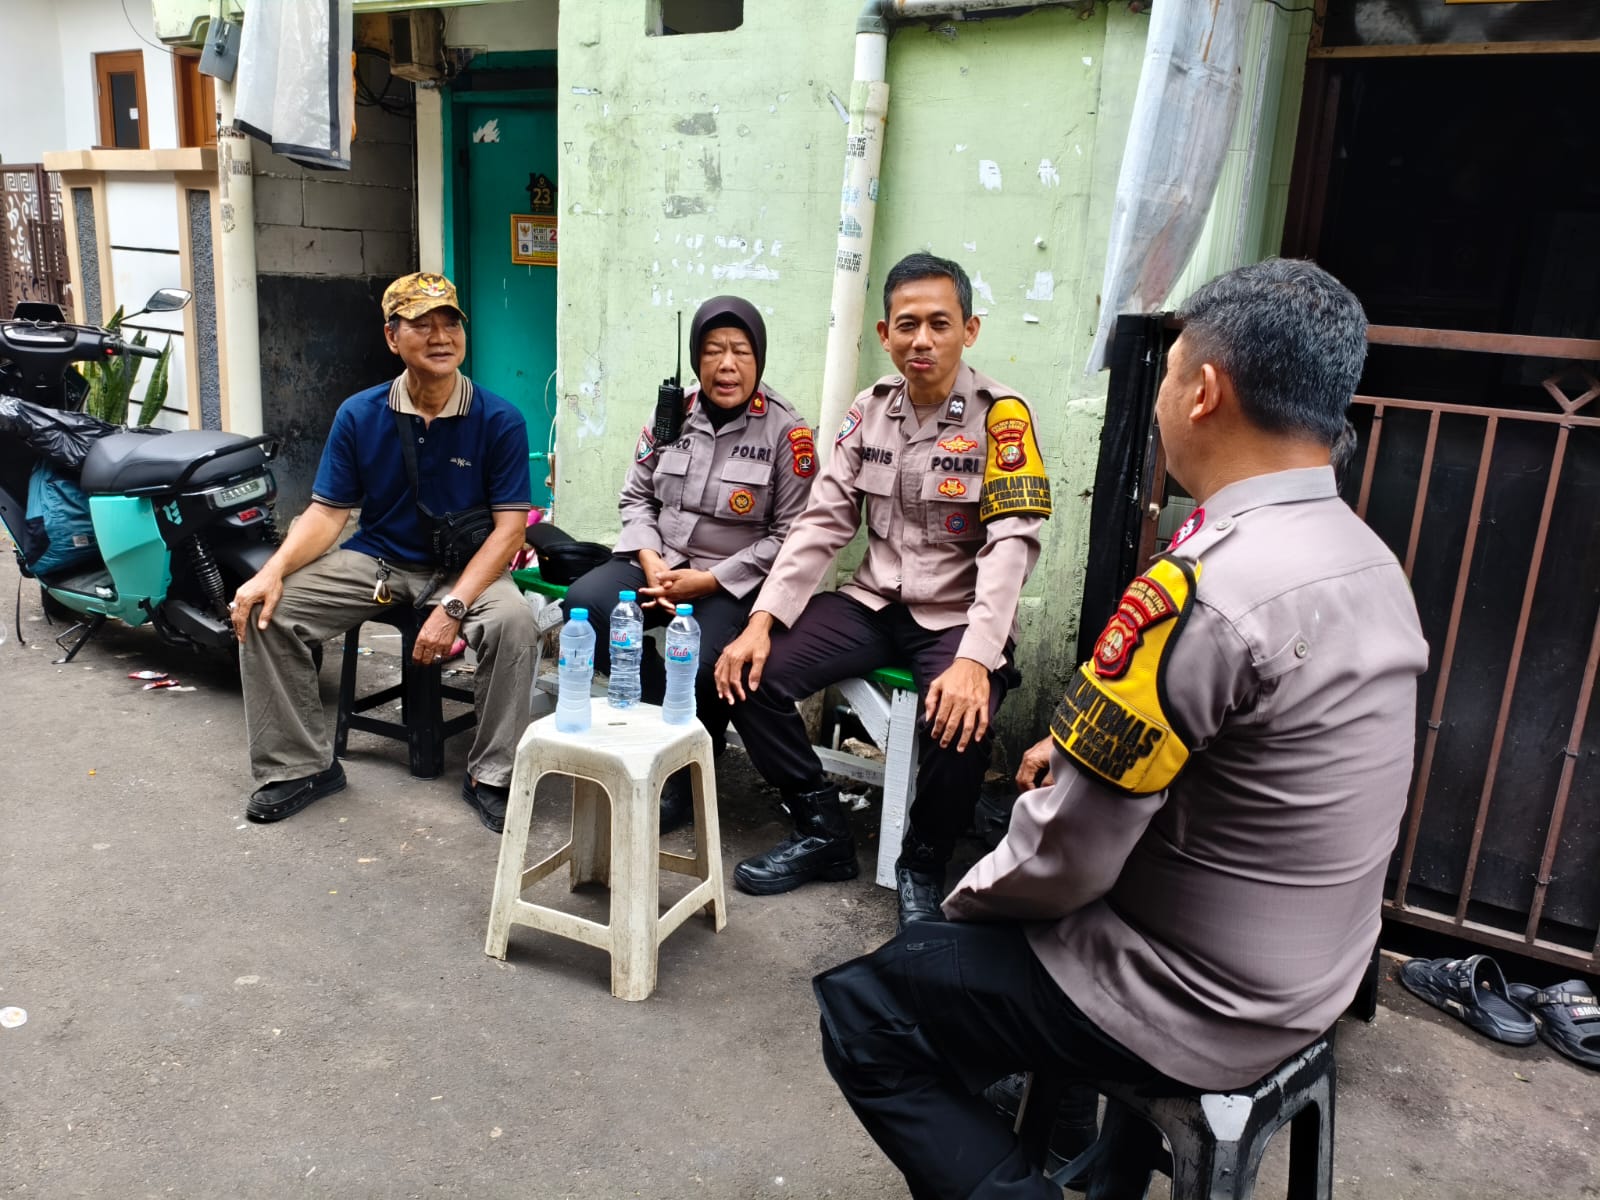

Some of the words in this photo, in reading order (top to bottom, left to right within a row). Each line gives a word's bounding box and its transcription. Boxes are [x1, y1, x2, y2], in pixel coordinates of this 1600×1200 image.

[533, 188, 551, 205] 23
[731, 445, 772, 462] POLRI
[931, 456, 980, 473] POLRI
